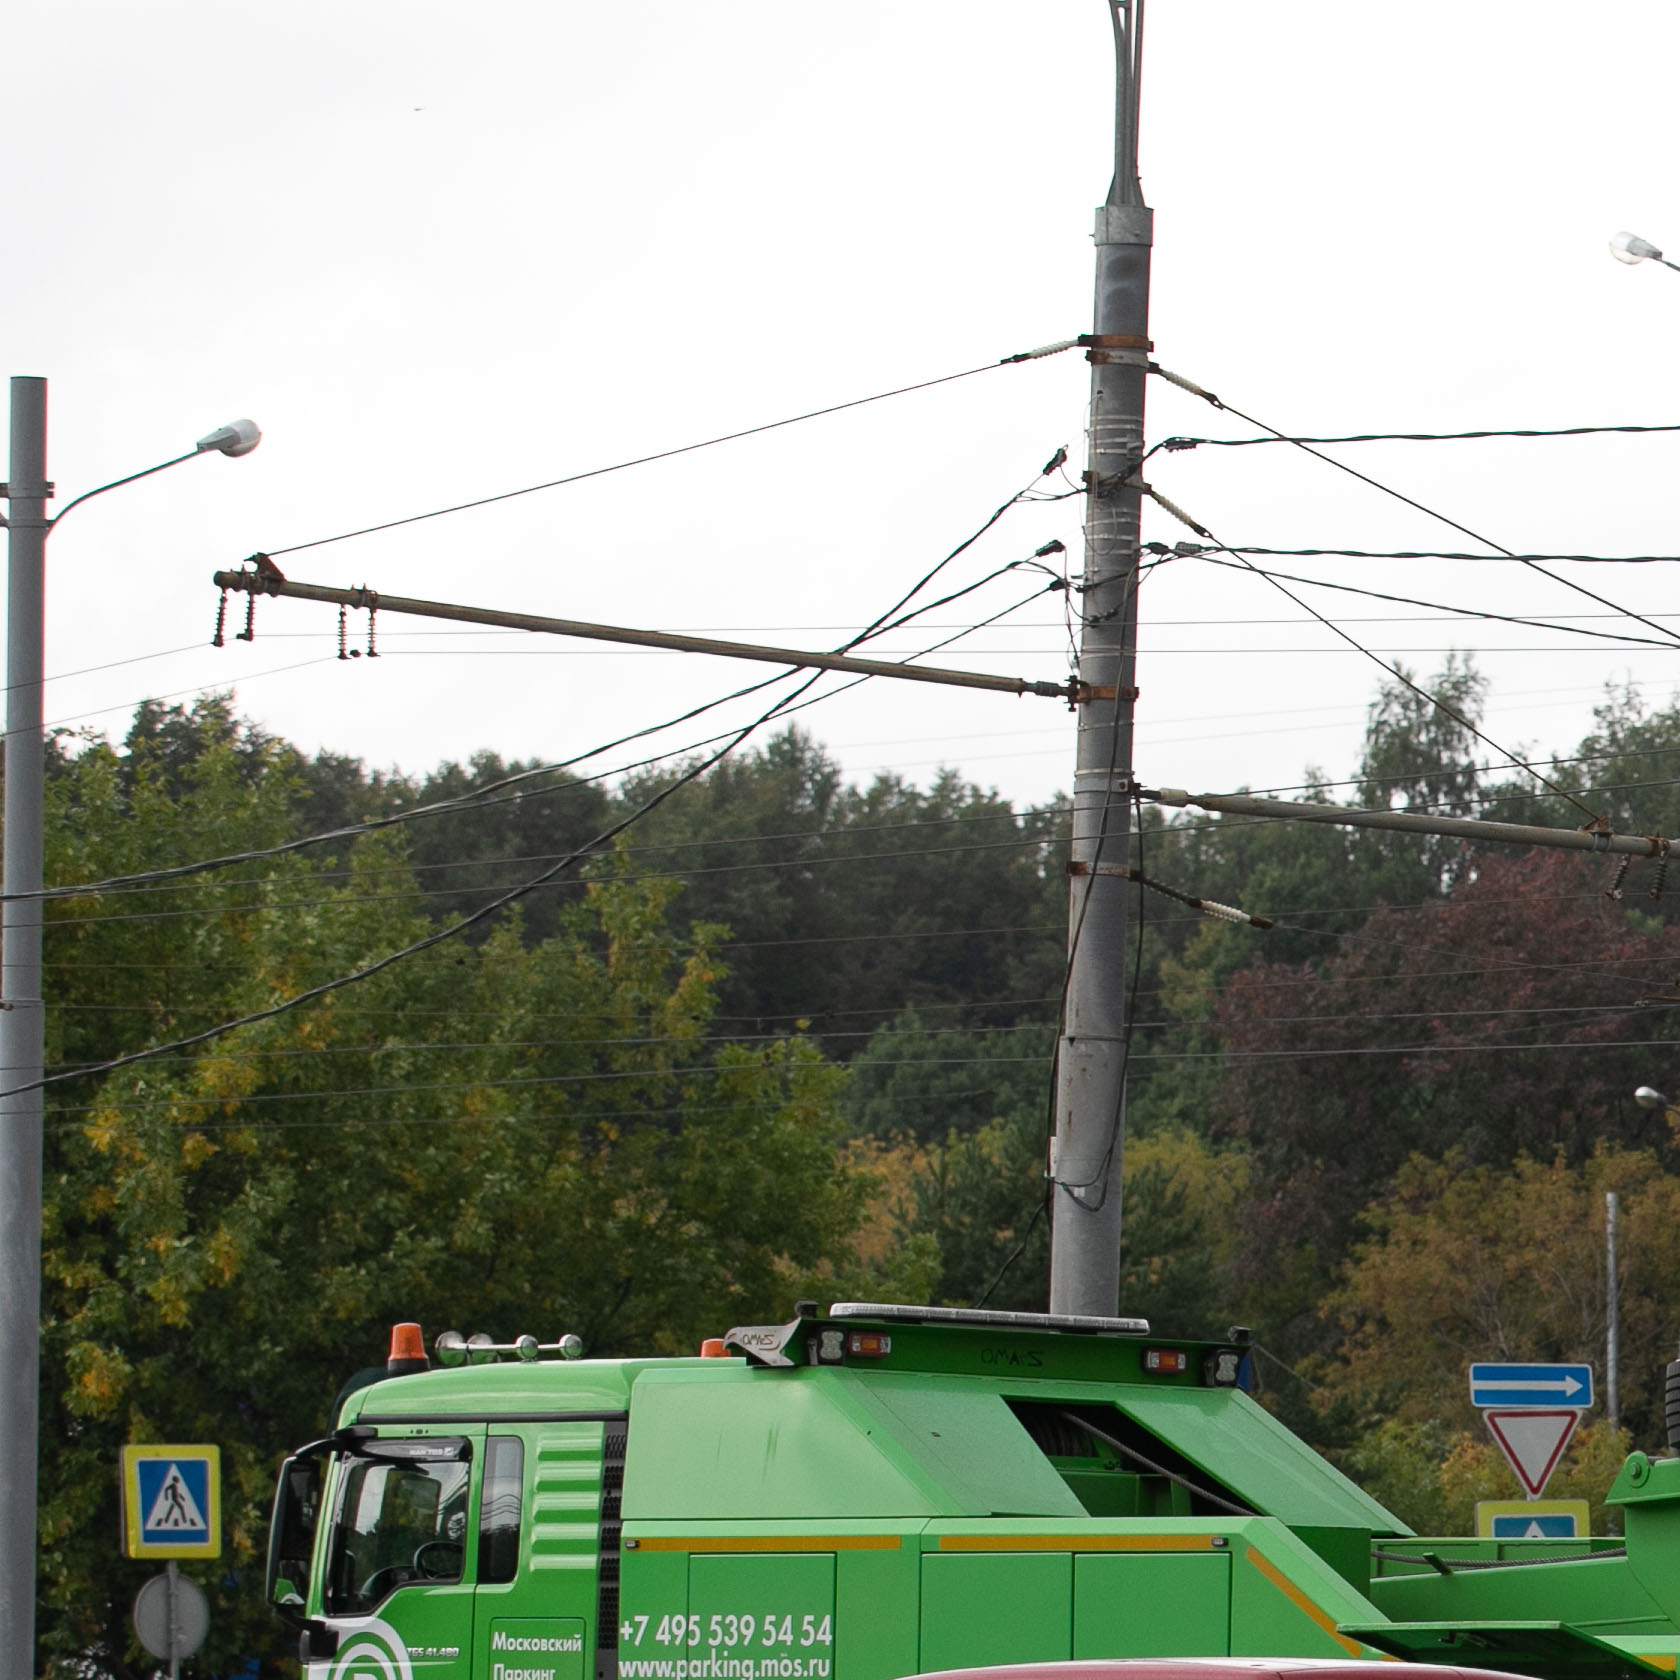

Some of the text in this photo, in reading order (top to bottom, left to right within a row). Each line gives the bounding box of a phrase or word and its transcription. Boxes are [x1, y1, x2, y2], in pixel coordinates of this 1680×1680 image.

[492, 1631, 582, 1653] Московский
[619, 1614, 833, 1646] +7 495 539 54 54
